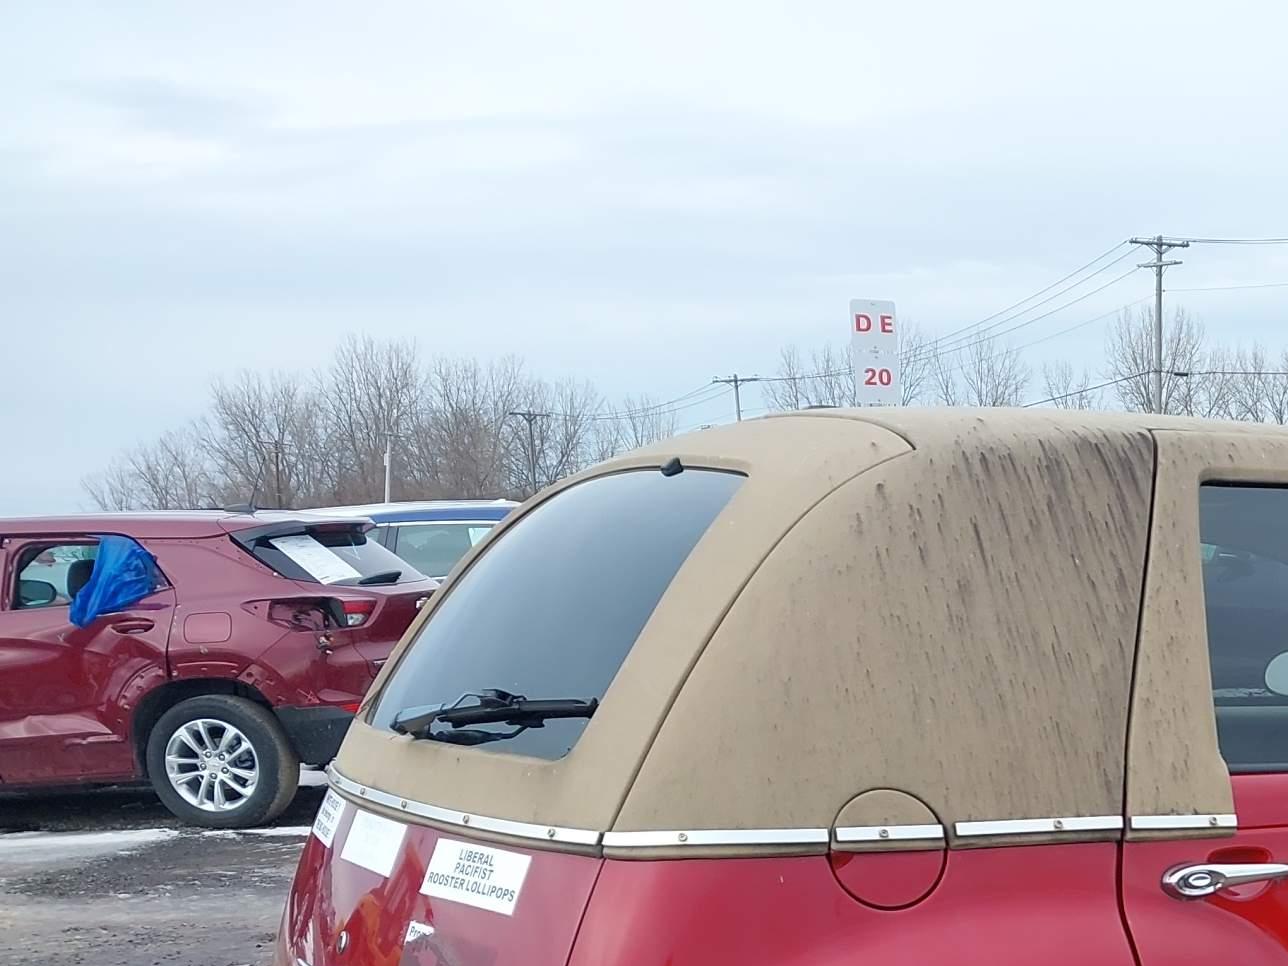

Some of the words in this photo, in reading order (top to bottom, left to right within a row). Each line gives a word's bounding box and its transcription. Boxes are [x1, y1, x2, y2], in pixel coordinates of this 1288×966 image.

[864, 367, 892, 386] 20
[458, 848, 494, 867] LIBERAL
[453, 862, 494, 880] PACIFIST
[427, 871, 465, 890] ROOSTER
[465, 879, 516, 902] LOLLIPOPS
